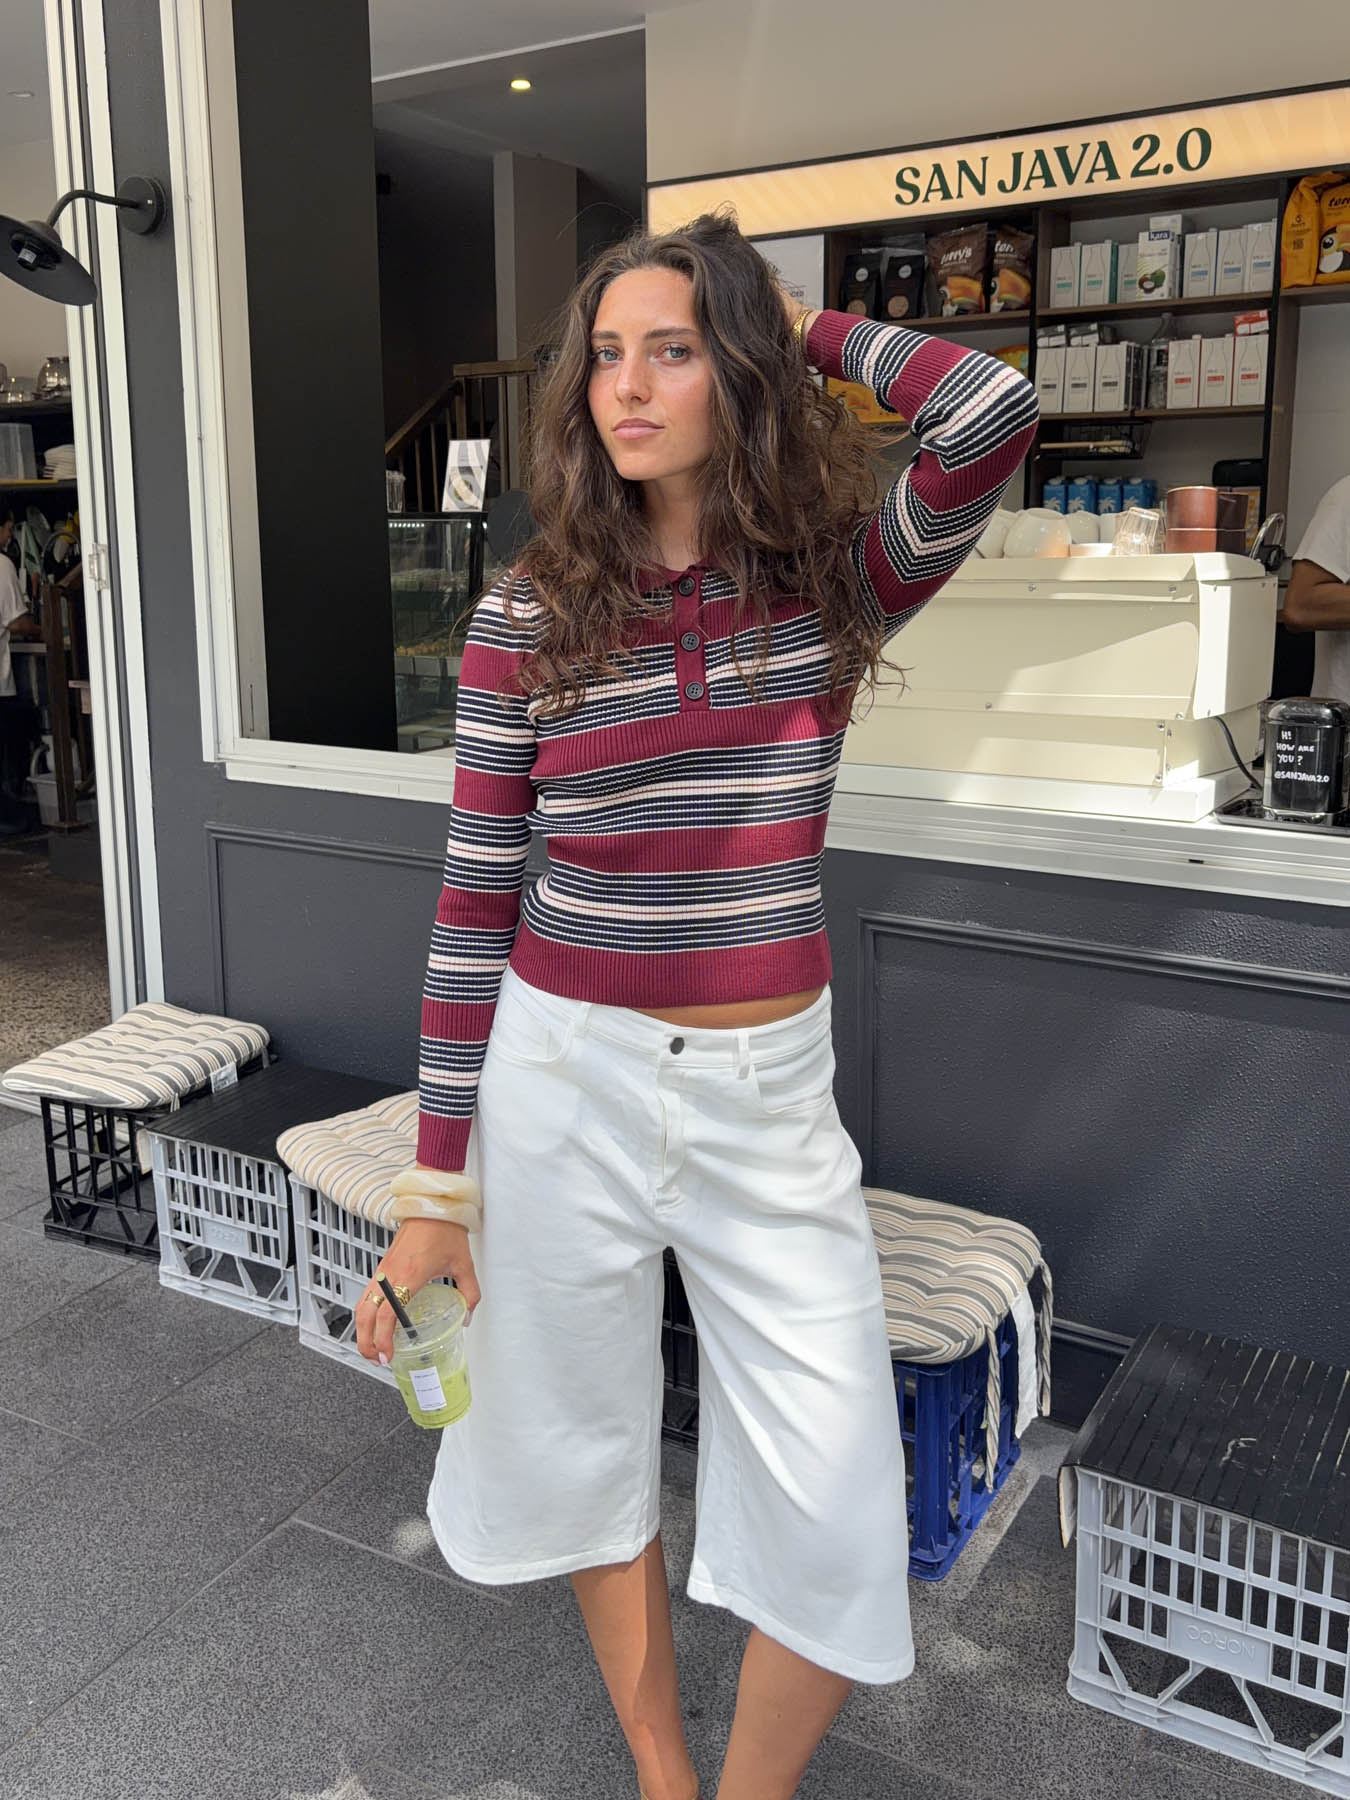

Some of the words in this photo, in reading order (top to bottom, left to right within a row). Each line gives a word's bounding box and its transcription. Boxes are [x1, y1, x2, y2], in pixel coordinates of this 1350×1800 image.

[895, 156, 989, 206] SAN
[997, 140, 1121, 194] JAVA
[1130, 127, 1212, 179] 2.0
[1275, 742, 1295, 752] HOW
[1297, 745, 1315, 753] ARE
[1277, 753, 1294, 764] YOU
